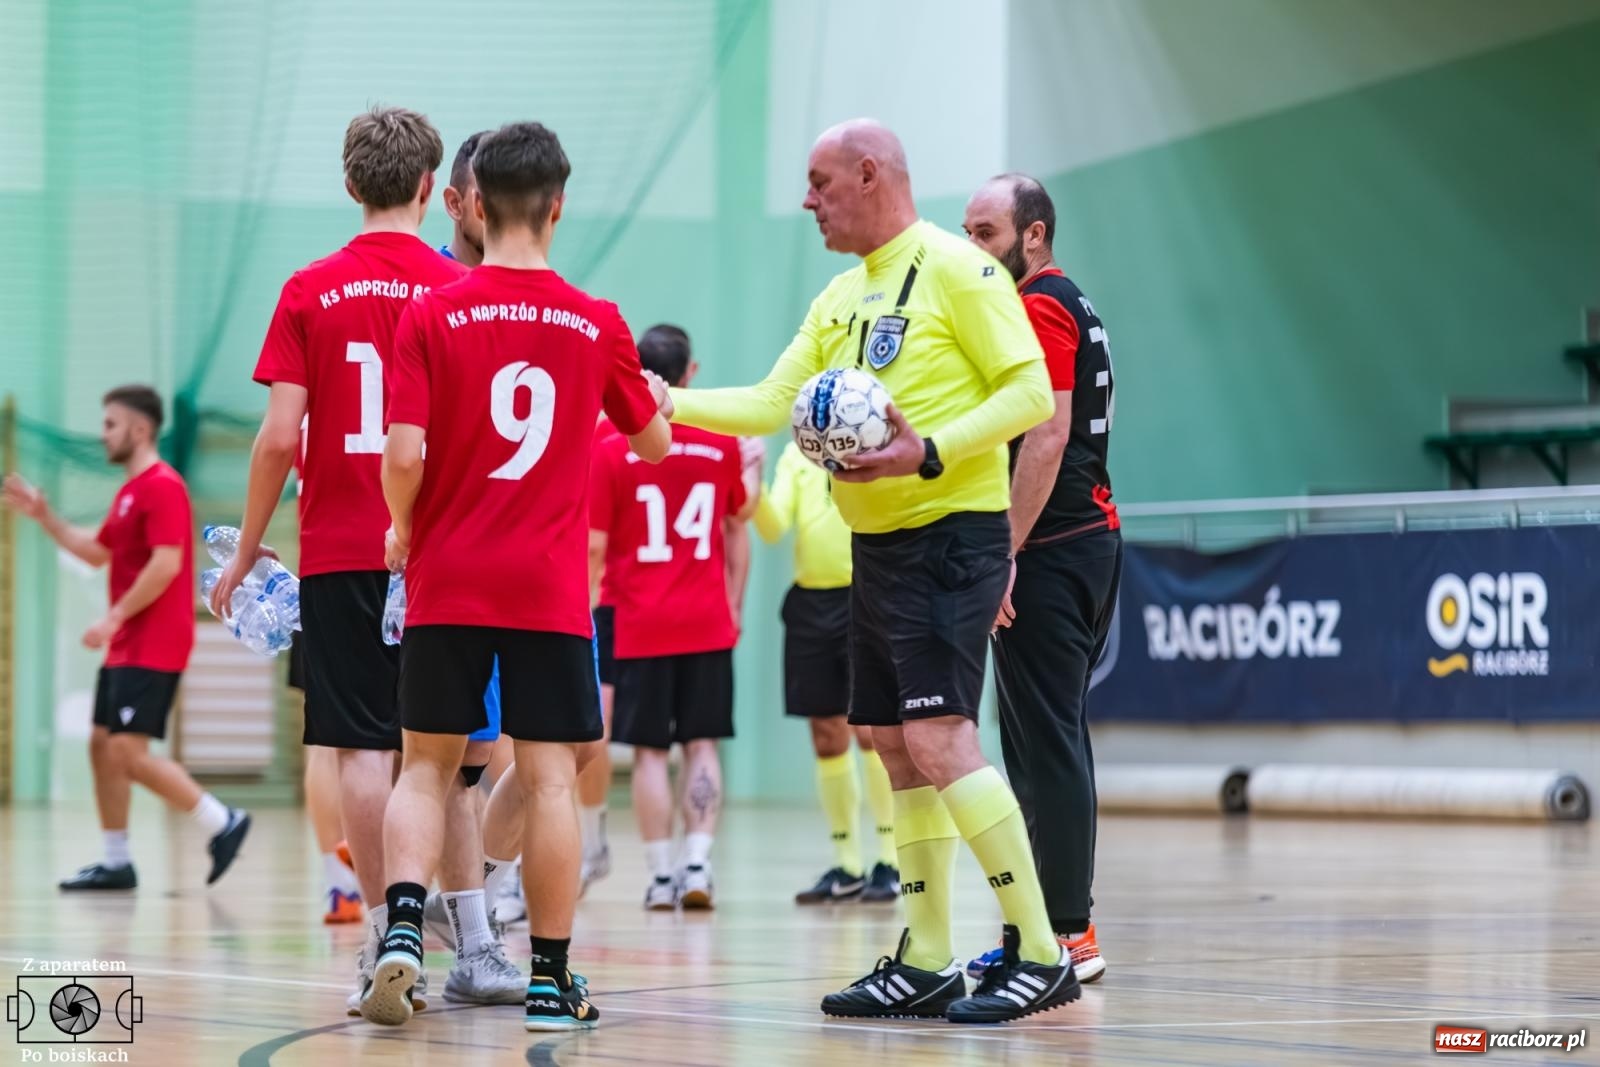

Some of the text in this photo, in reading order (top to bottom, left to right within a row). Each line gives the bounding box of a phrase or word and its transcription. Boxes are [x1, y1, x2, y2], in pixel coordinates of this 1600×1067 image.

[319, 289, 341, 310] KS
[343, 279, 409, 299] NAPRZÓD
[446, 302, 600, 342] KS NAPRZÓD BORUCIN
[487, 361, 556, 480] 9
[636, 482, 716, 562] 14
[1143, 585, 1342, 661] RACIBÓRZ
